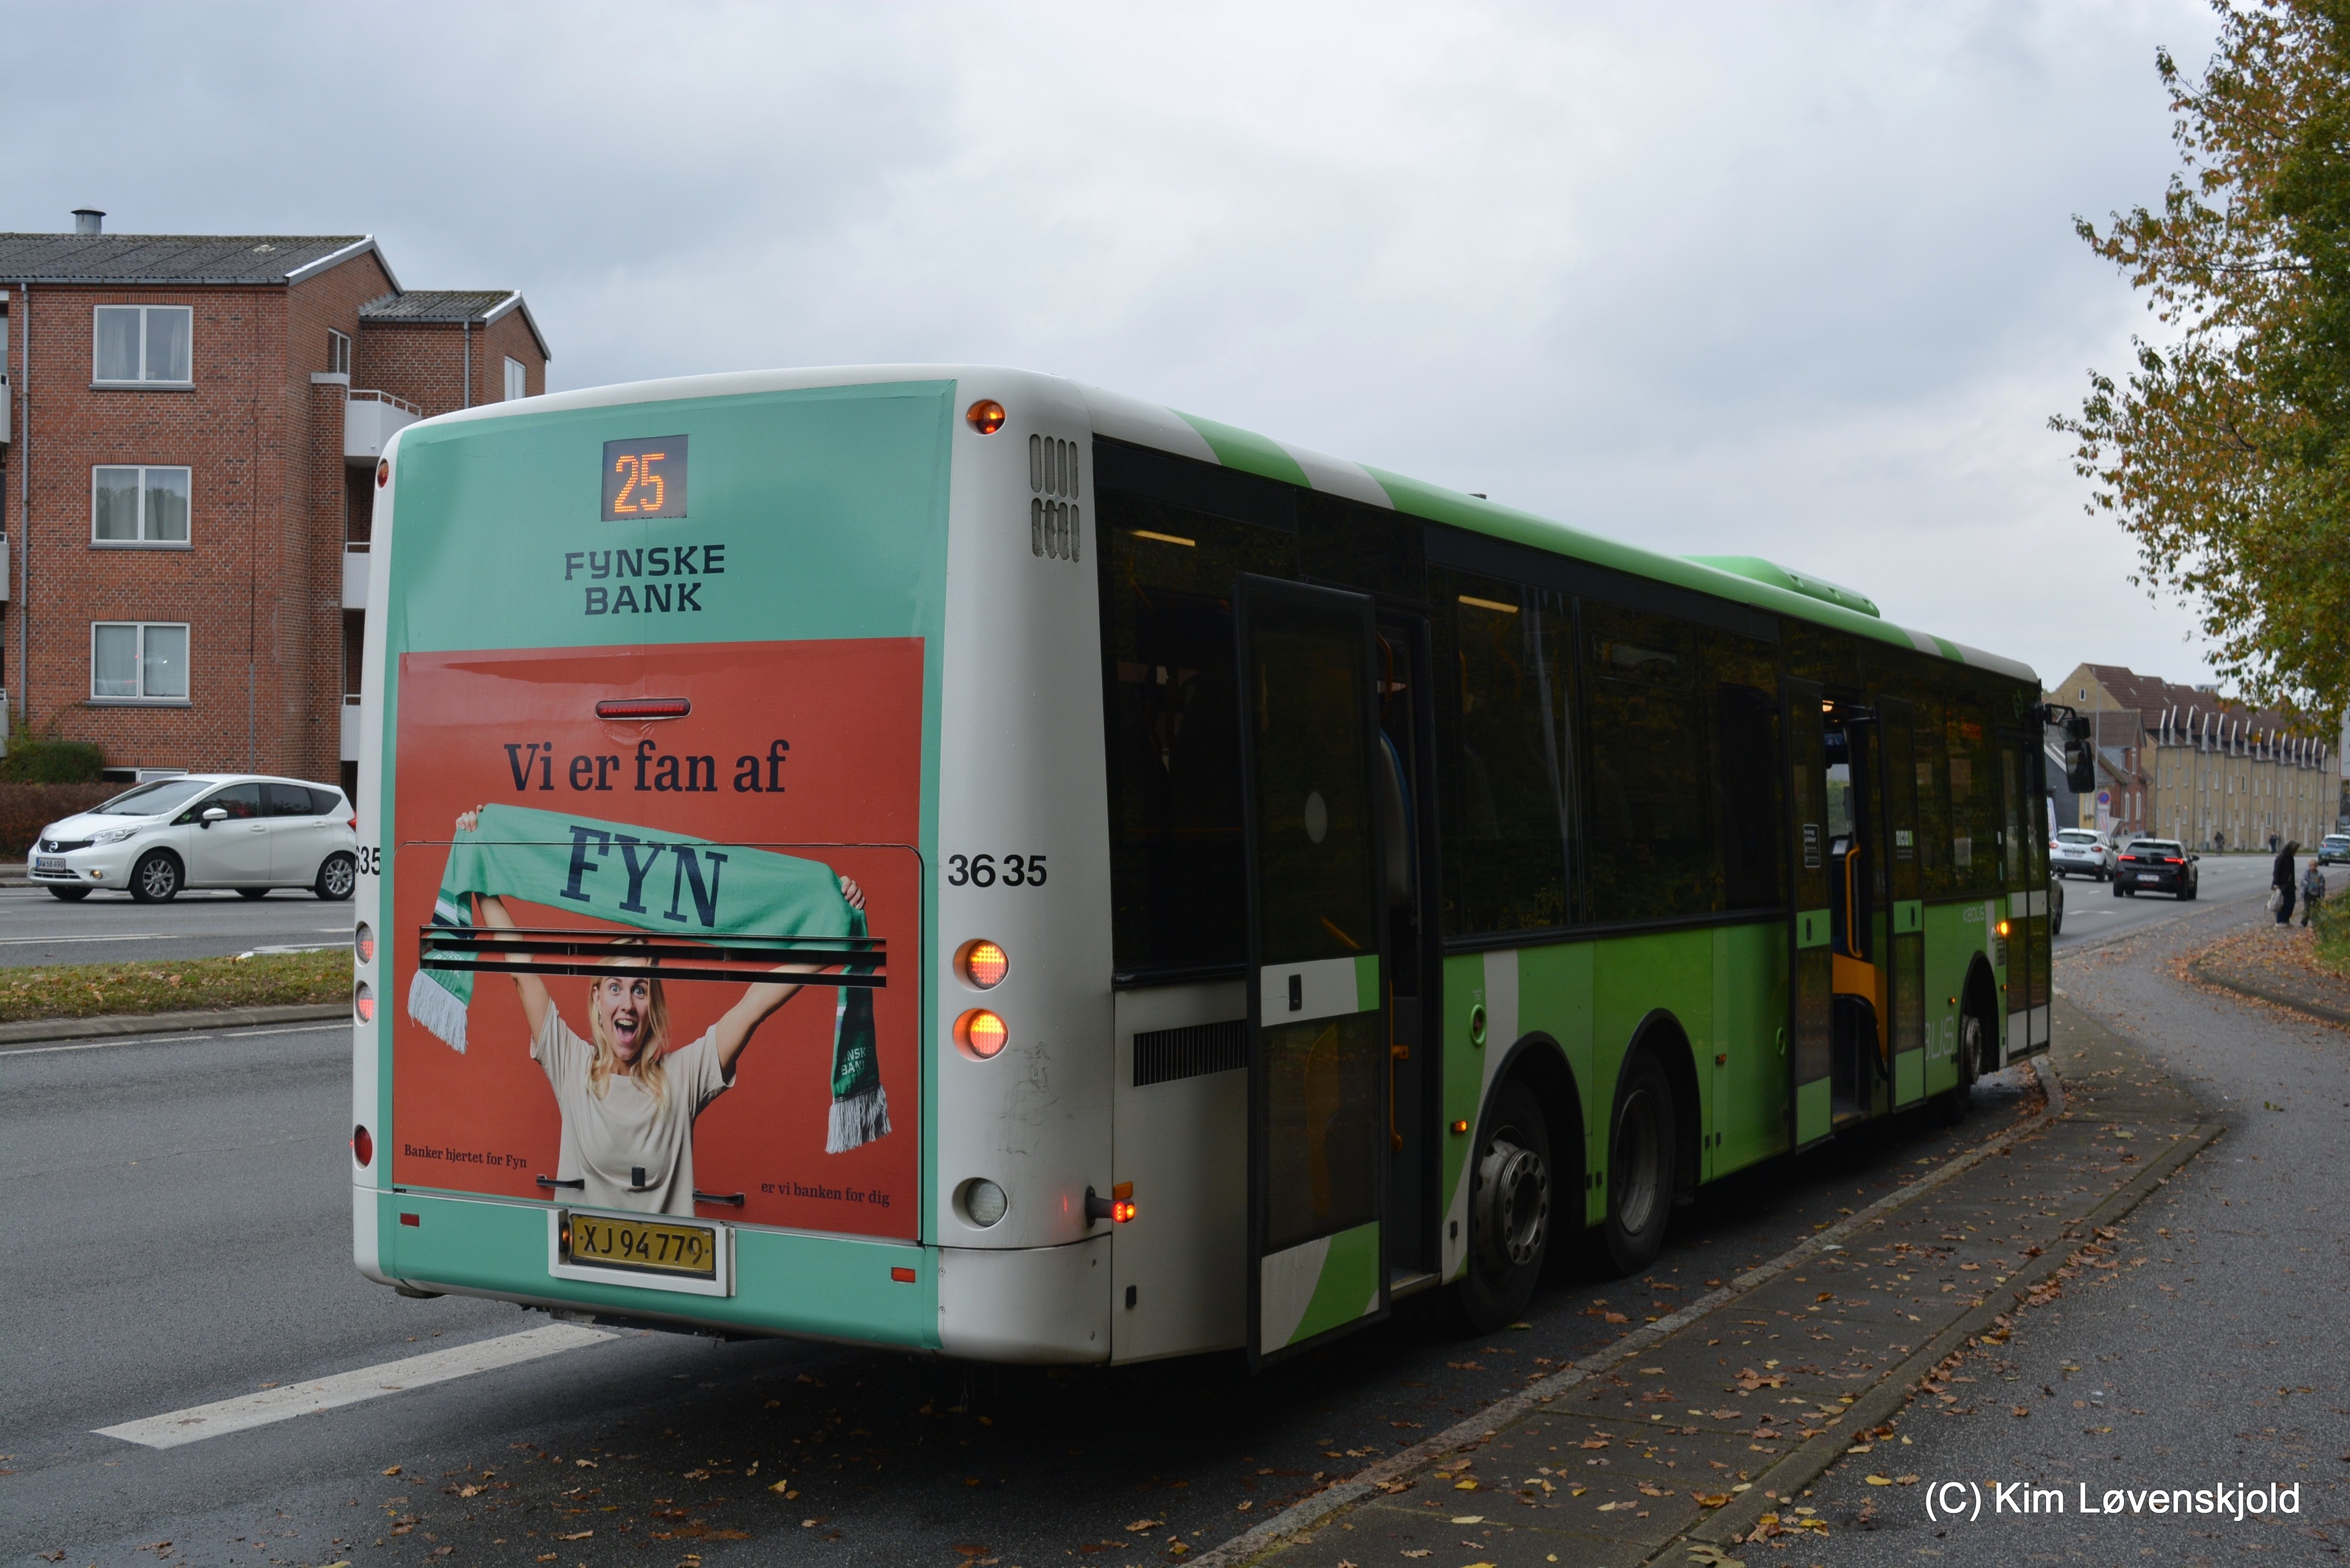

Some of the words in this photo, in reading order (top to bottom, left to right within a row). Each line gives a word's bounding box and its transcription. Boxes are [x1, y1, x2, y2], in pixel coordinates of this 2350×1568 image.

[614, 453, 665, 513] 25
[565, 544, 726, 580] FYNSKE
[585, 582, 702, 615] BANK
[504, 741, 554, 791] Vi
[569, 755, 620, 791] er
[634, 739, 718, 792] fan
[733, 739, 790, 793] af
[559, 824, 728, 928] FYN
[948, 854, 1048, 888] 3635
[404, 1144, 443, 1160] Banker
[446, 1148, 484, 1163] hjertet
[487, 1152, 503, 1165] for
[505, 1154, 527, 1170] Fyn
[761, 1182, 775, 1193] er
[778, 1182, 791, 1195] vi
[794, 1182, 842, 1200] banken
[845, 1187, 865, 1202] for
[868, 1190, 890, 1208] dig
